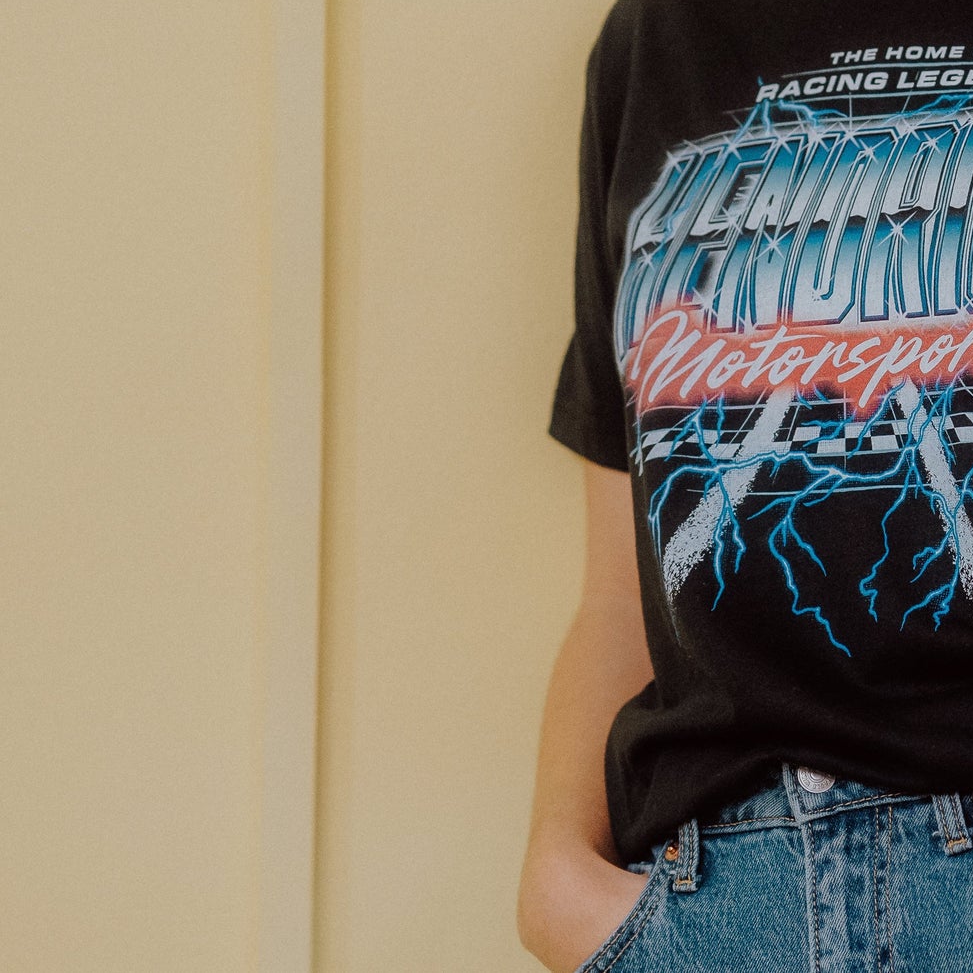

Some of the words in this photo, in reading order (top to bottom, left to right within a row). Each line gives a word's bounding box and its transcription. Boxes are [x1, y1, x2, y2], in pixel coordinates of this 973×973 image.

[830, 48, 876, 65] THE
[885, 46, 963, 61] HOME
[756, 71, 888, 103] RACING
